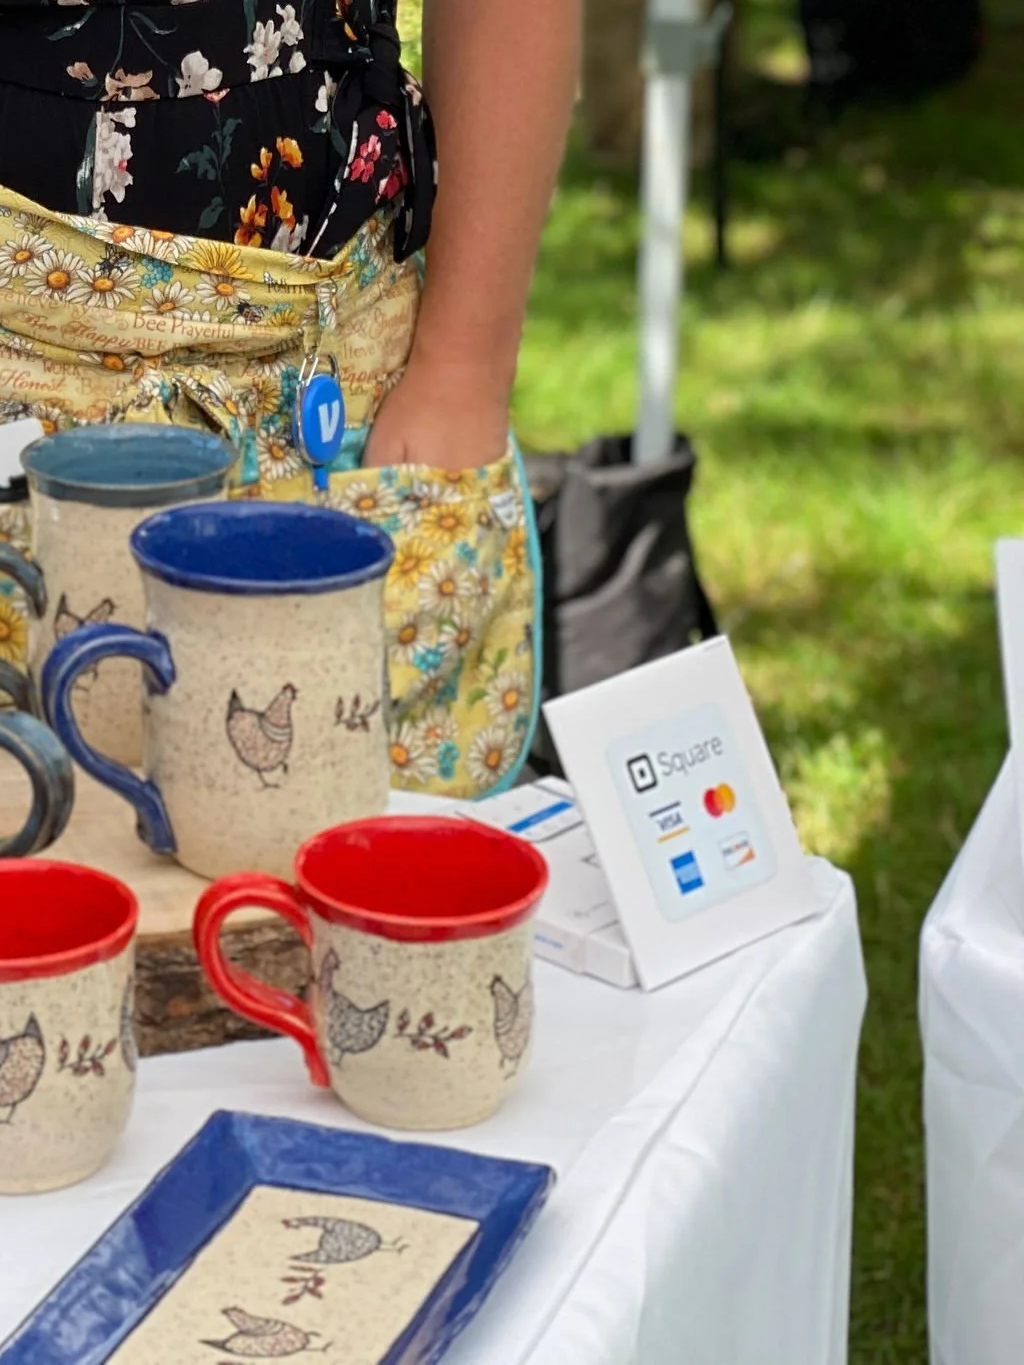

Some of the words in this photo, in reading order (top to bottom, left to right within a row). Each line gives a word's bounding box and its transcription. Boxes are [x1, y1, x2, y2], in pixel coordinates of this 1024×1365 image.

[61, 321, 133, 348] Happy
[132, 312, 166, 332] Bee
[169, 315, 234, 340] Prayerful
[317, 399, 340, 443] V
[657, 736, 724, 777] Square
